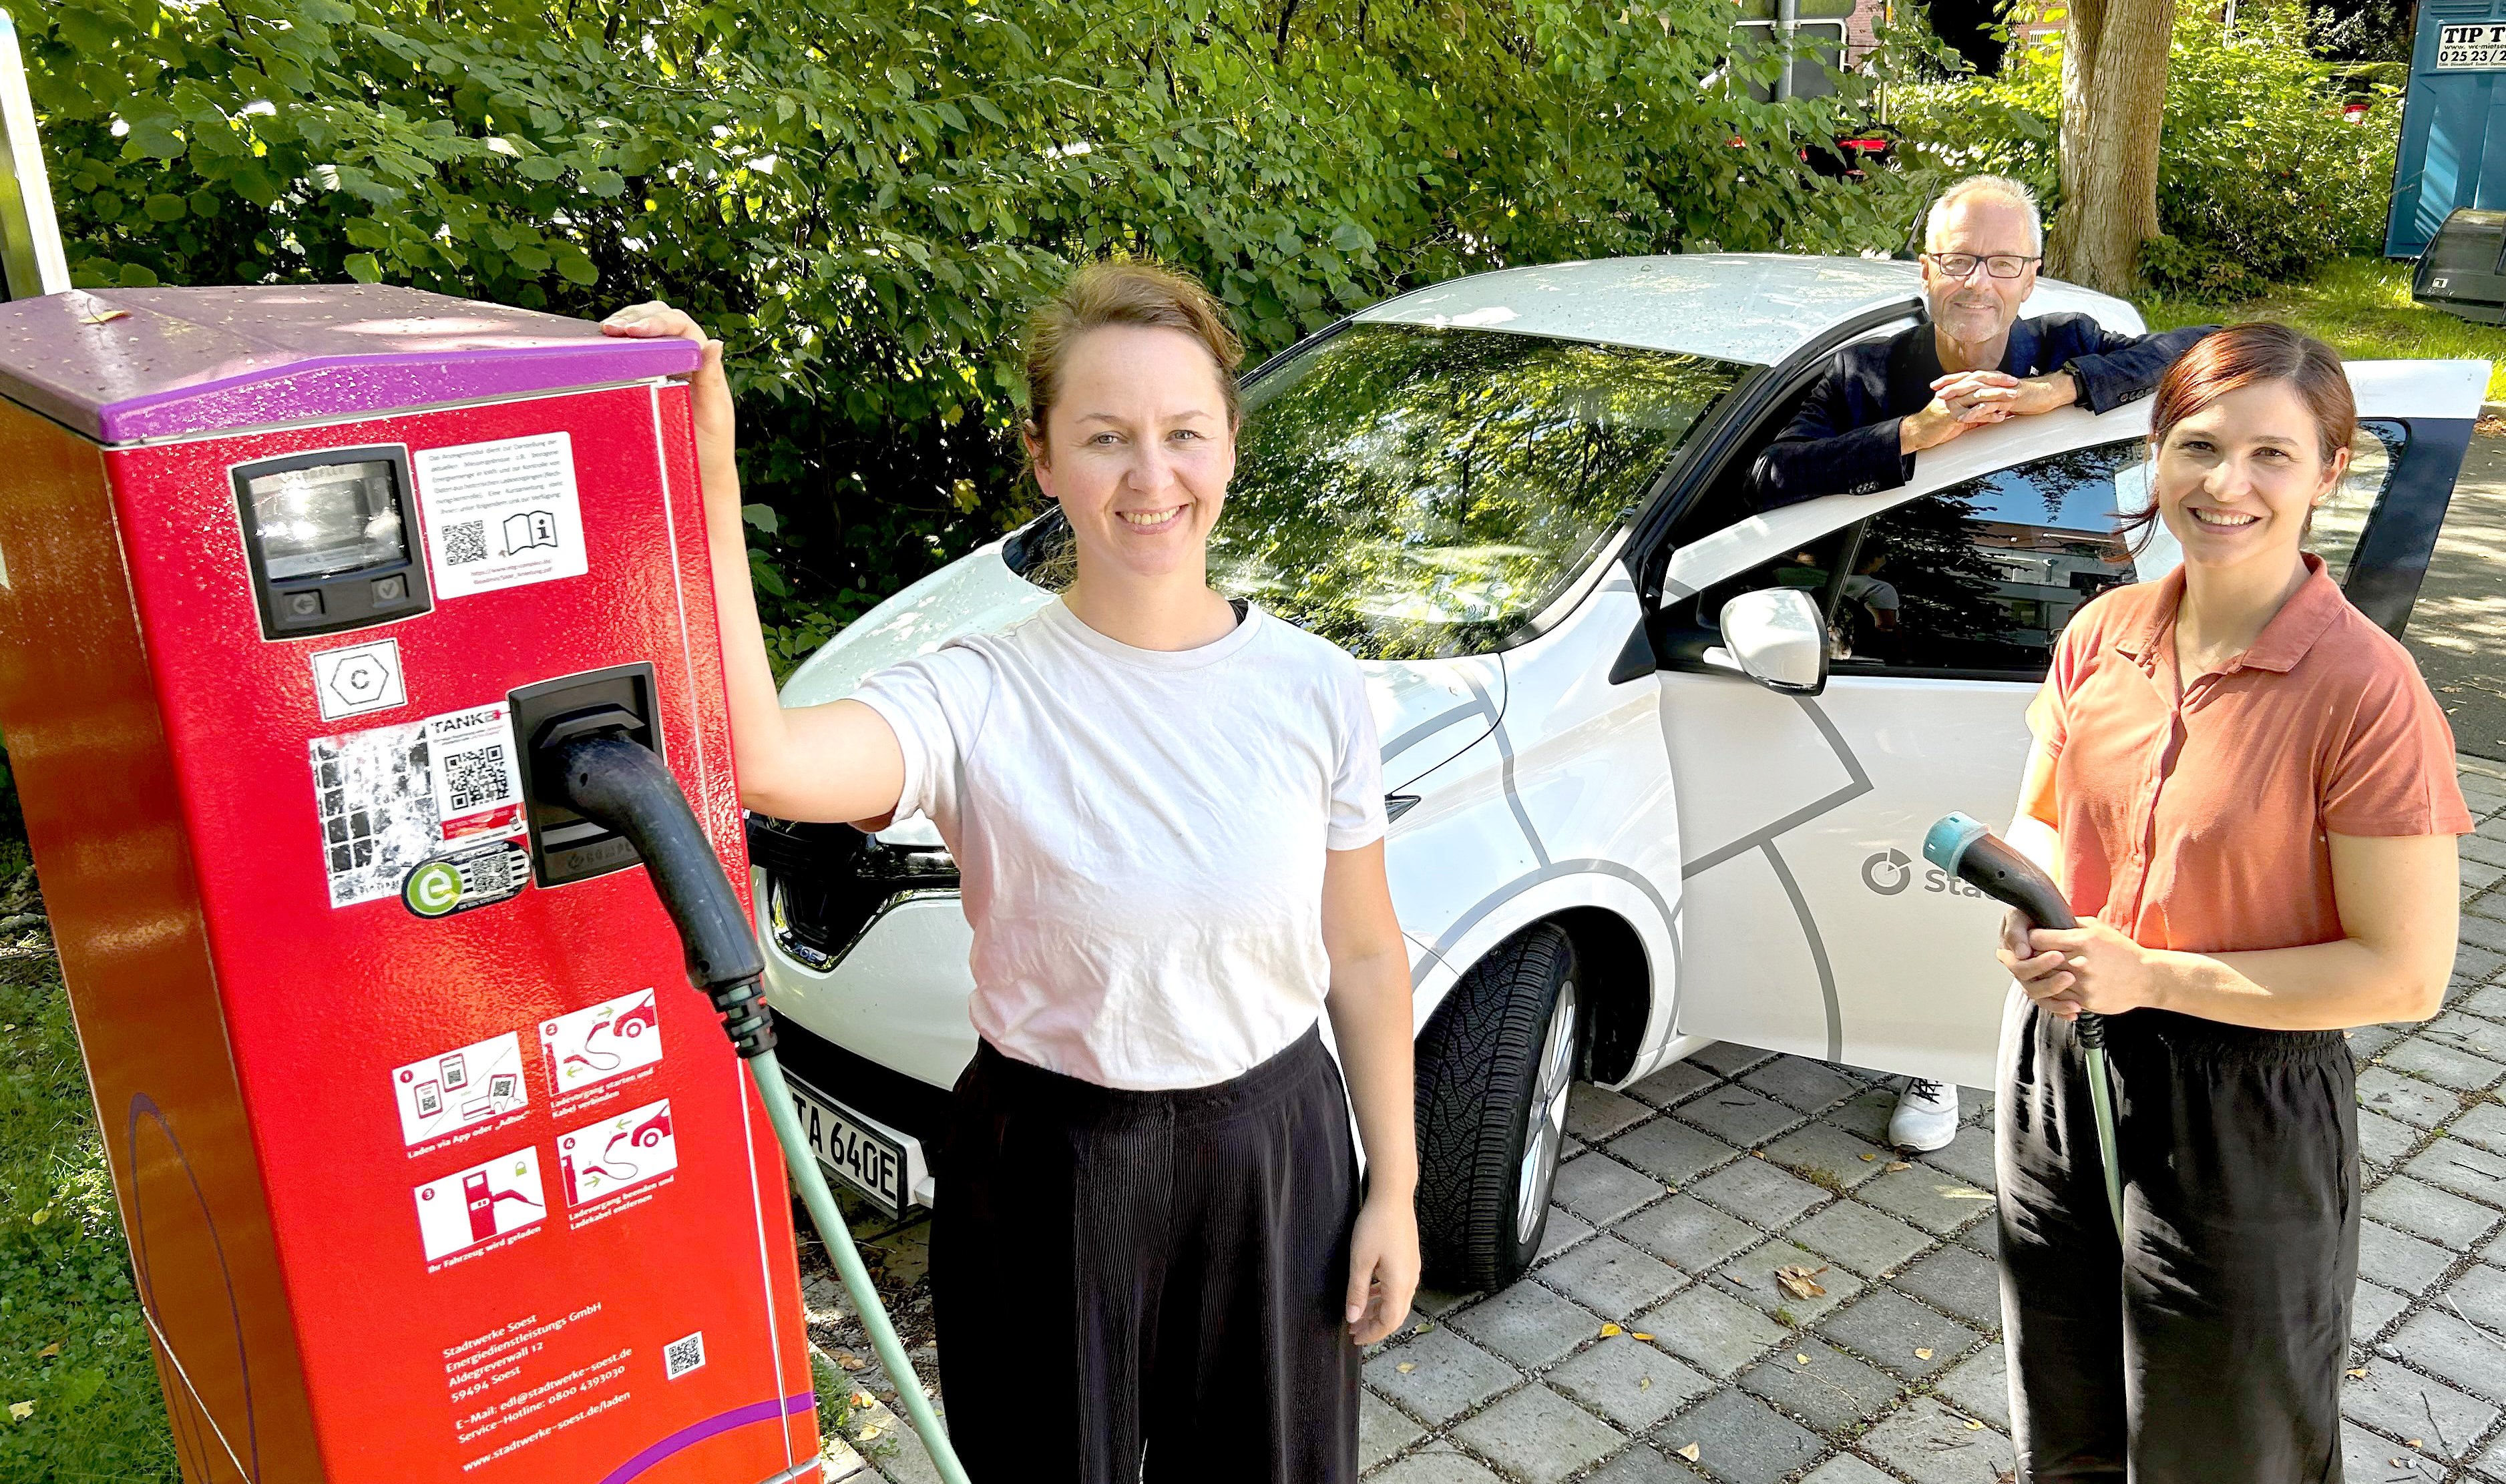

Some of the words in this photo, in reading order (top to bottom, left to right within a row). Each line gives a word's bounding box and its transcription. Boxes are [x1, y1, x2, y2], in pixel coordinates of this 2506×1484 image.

[2444, 27, 2483, 43] TIP
[2489, 27, 2506, 43] T
[351, 669, 370, 690] C
[1924, 869, 1997, 901] Sta
[636, 1067, 654, 1079] und
[552, 1104, 577, 1120] Kabel
[407, 1144, 436, 1160] Laden
[437, 1139, 451, 1149] via
[453, 1132, 471, 1144] App
[472, 1124, 493, 1137] oder
[830, 1122, 897, 1202] 640E
[658, 1174, 675, 1187] und
[427, 1263, 442, 1274] Ihr
[443, 1248, 485, 1268] Fahrzeug
[485, 1238, 506, 1252] wird
[507, 1226, 542, 1246] geladen
[442, 1327, 505, 1359] Stadtwerke
[507, 1314, 538, 1332] Soest
[445, 1318, 568, 1373] Energiedienstleistungs
[568, 1302, 602, 1322] GmbH
[448, 1346, 528, 1387] Aldegreverwall
[531, 1341, 544, 1354] 12
[451, 1380, 490, 1403] 59494
[491, 1367, 521, 1385] Soest
[455, 1405, 498, 1430] E-Mail:
[499, 1347, 633, 1411] edl@stadtwerke-soest.de
[458, 1399, 546, 1443] Service-Hotline:
[548, 1386, 578, 1405] 0800
[579, 1365, 626, 1392] 4393030
[463, 1391, 631, 1472] www.stadtwerke-soest.de/laden
